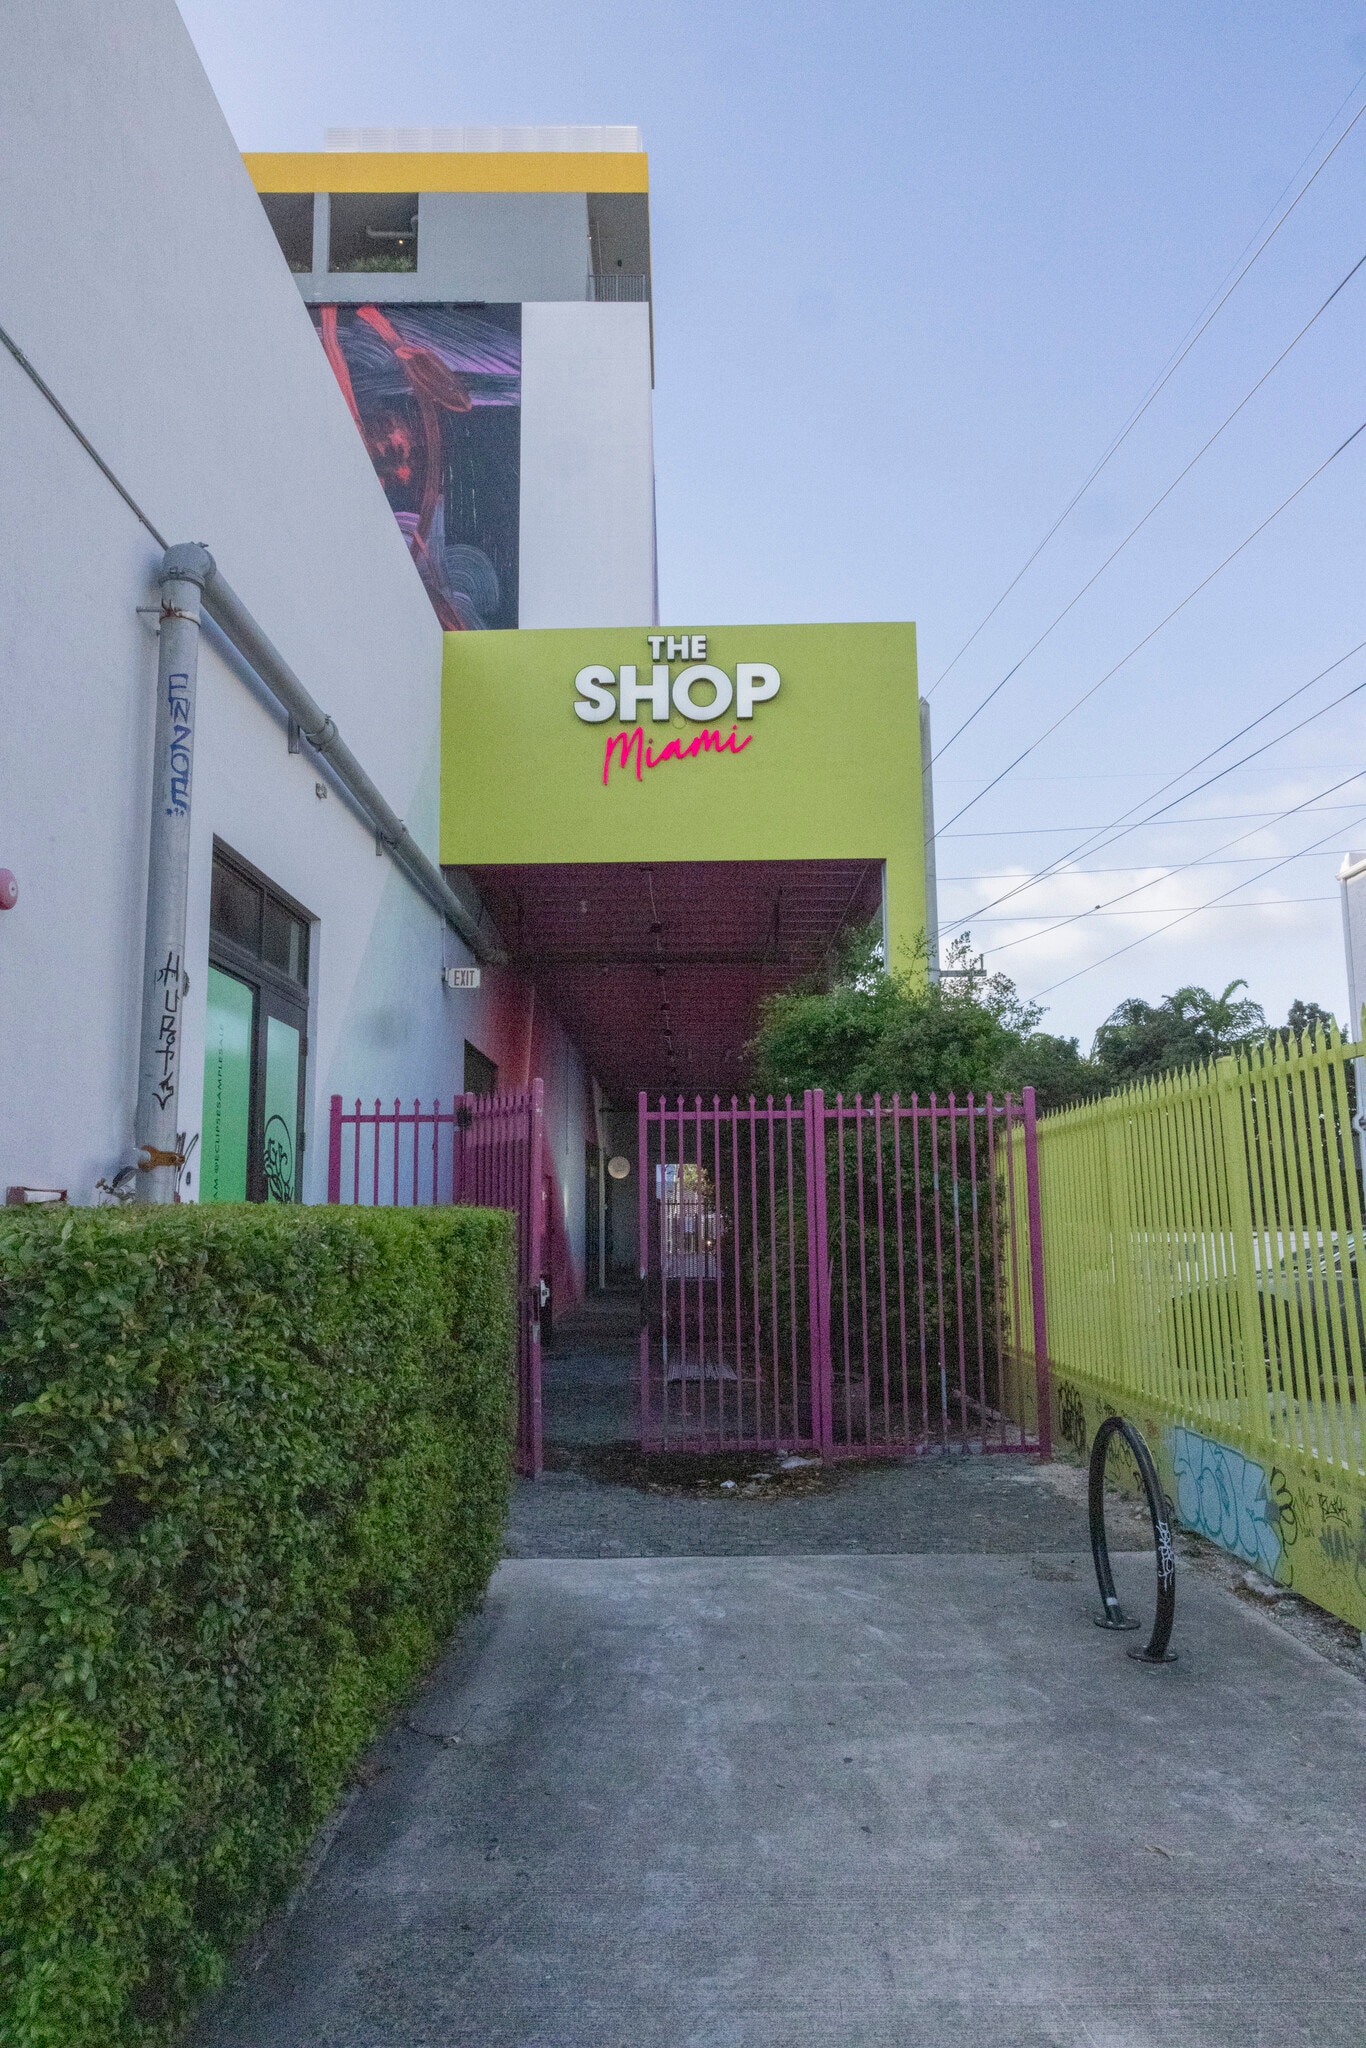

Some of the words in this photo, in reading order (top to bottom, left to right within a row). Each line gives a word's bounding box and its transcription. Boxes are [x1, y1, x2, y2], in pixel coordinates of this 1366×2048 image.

[647, 634, 707, 662] THE
[573, 662, 781, 723] SHOP
[603, 724, 753, 786] Miami
[454, 970, 475, 986] EXIT
